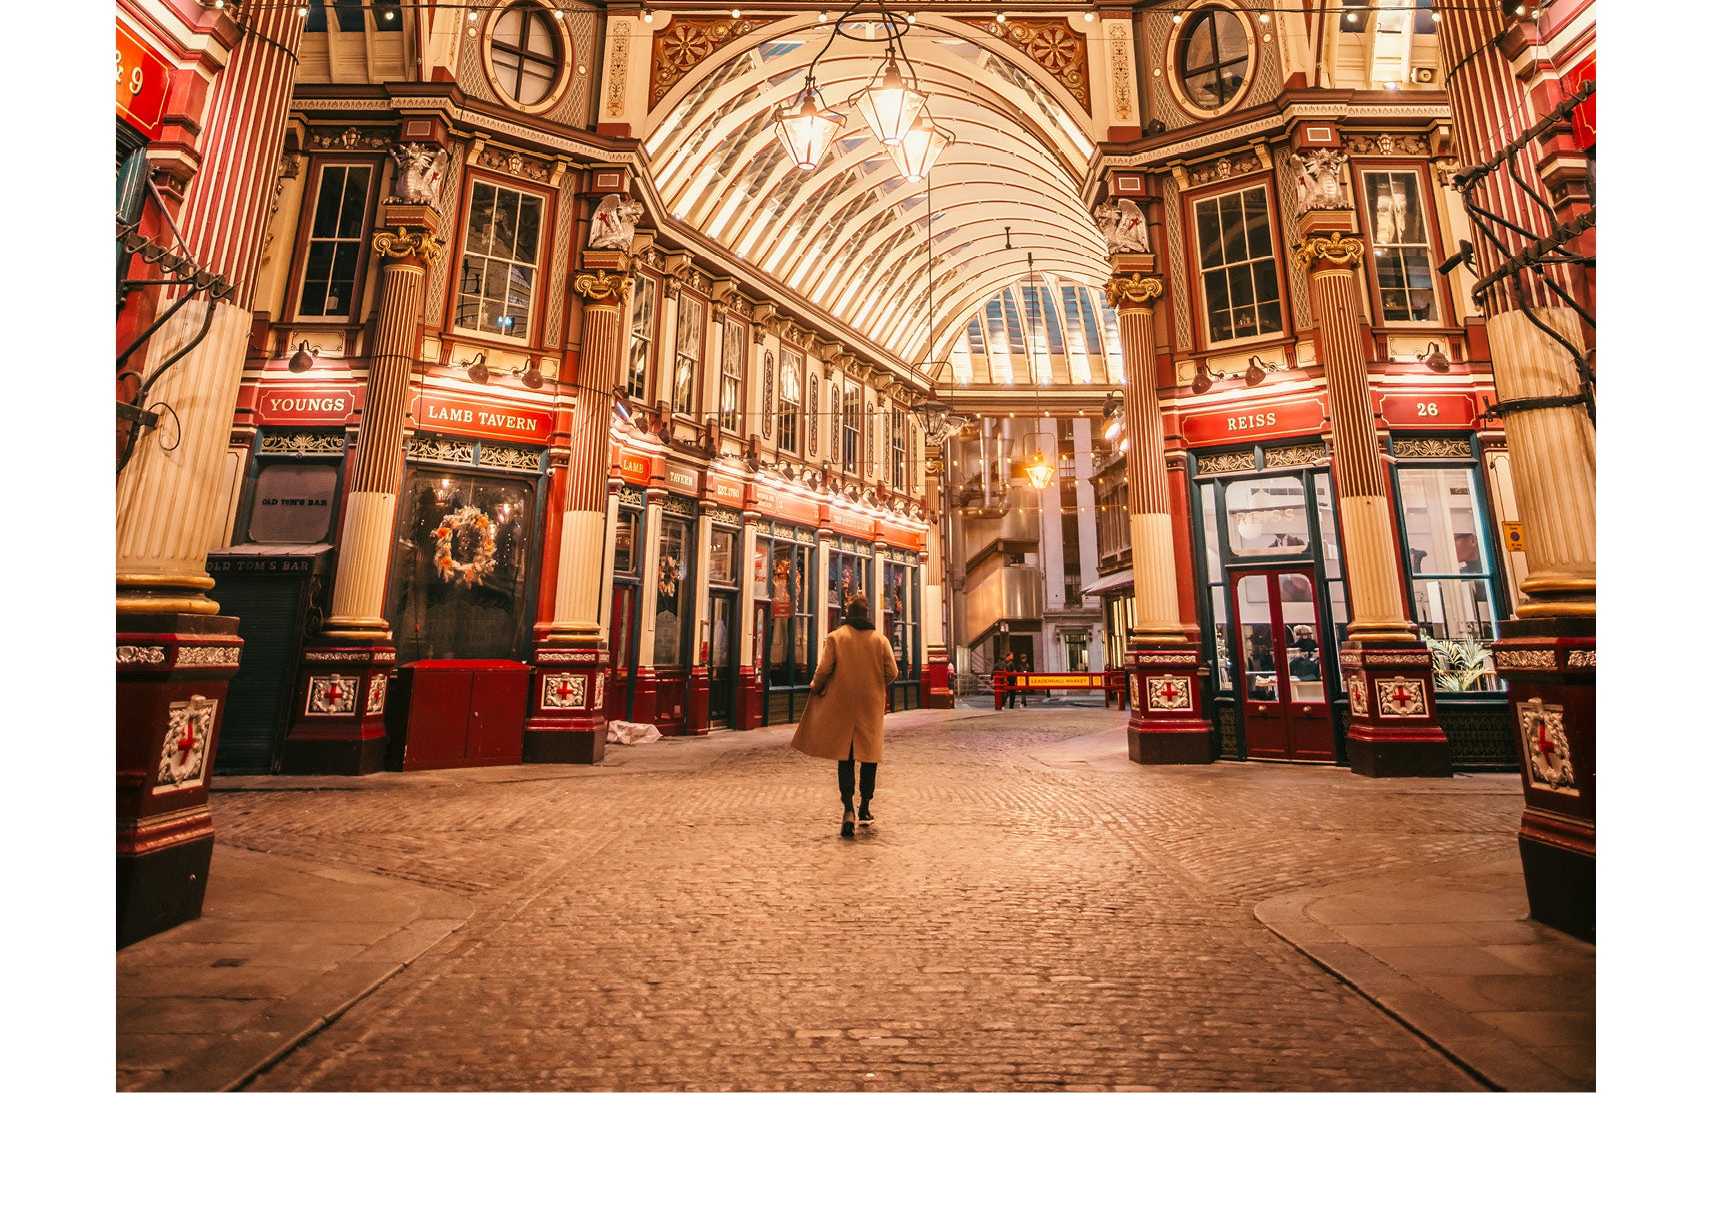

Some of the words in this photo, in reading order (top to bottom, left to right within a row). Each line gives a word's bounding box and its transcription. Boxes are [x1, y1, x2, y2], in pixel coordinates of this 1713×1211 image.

[129, 66, 144, 95] 9
[270, 398, 346, 412] YOUNGS
[1416, 402, 1439, 417] 26
[428, 405, 473, 423] LAMB
[478, 412, 538, 431] TAVERN
[1227, 412, 1277, 431] REISS
[623, 459, 644, 474] LAMB
[670, 471, 693, 486] TAVERN
[262, 498, 278, 506] OLD
[281, 498, 305, 506] TOM'S
[307, 498, 327, 506] BAR
[1236, 508, 1296, 526] REISS
[206, 560, 231, 571] OLD
[237, 560, 277, 571] TOM'S
[282, 560, 309, 571] BAR
